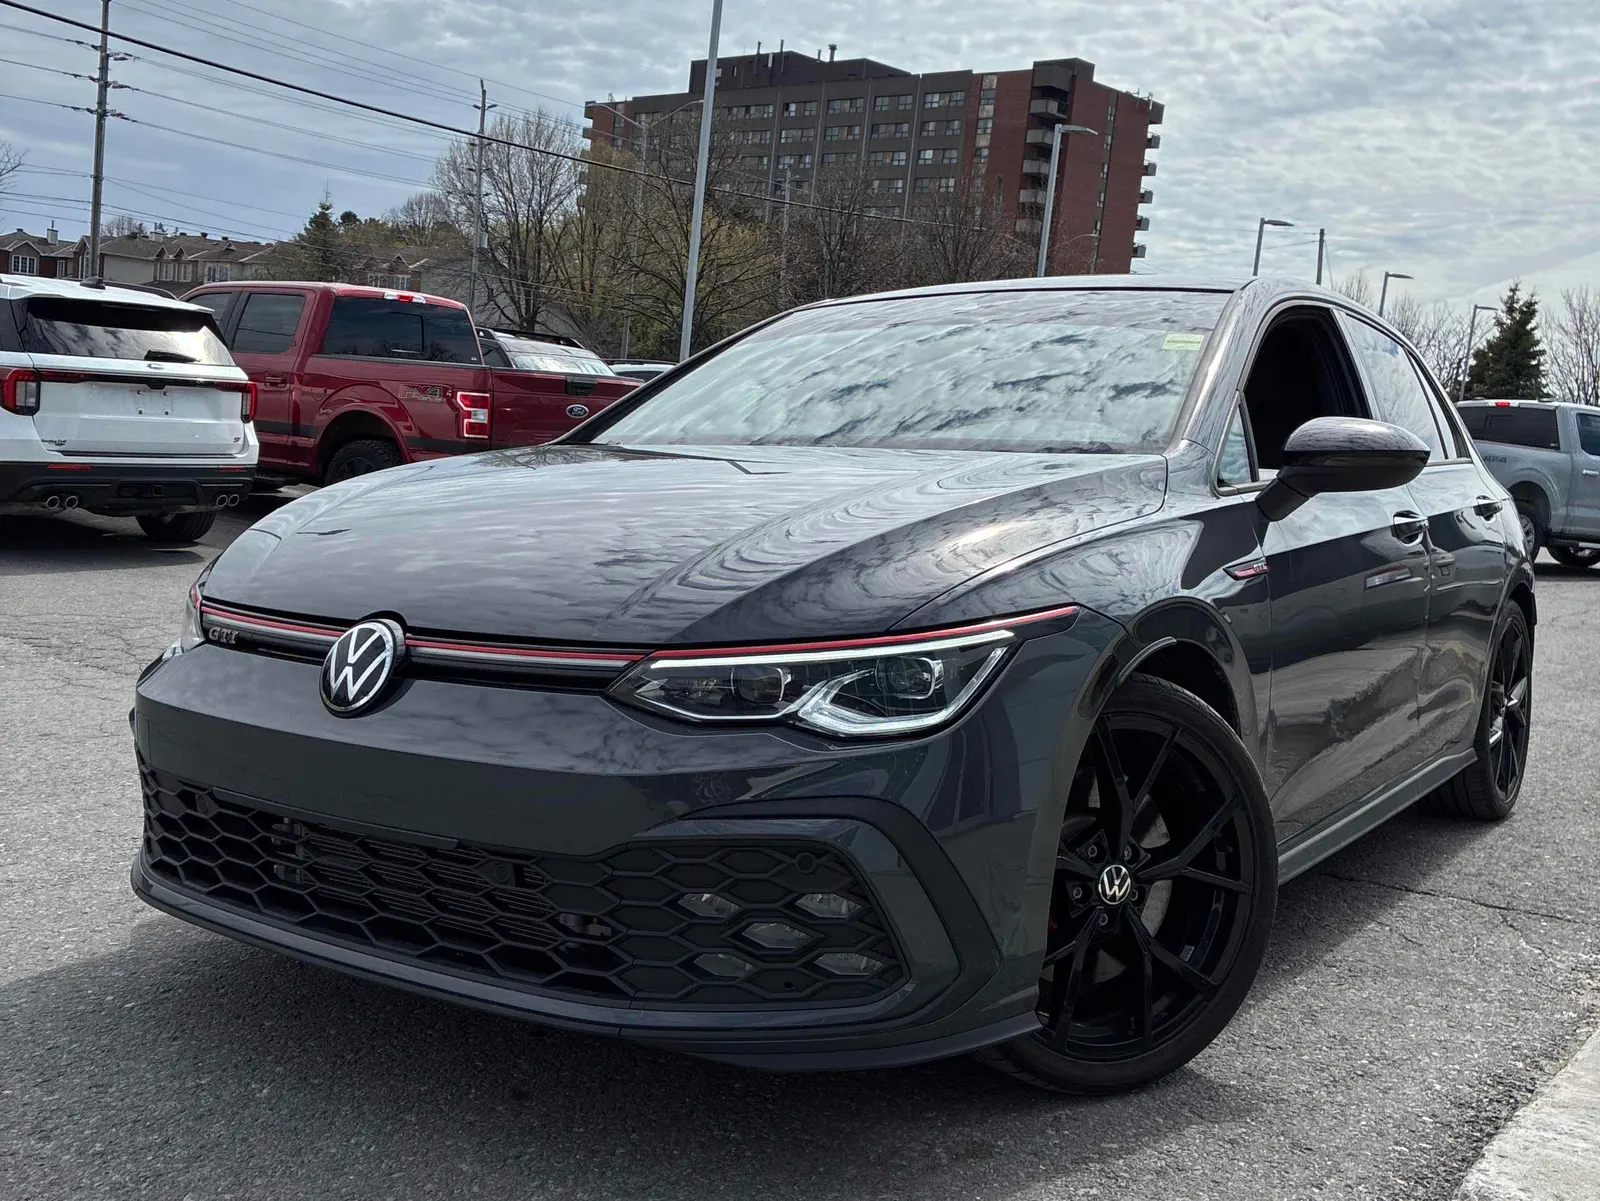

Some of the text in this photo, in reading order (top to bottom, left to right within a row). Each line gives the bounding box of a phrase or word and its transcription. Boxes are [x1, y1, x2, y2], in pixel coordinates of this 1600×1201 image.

[208, 626, 239, 645] GTI
[324, 624, 392, 706] VW
[1100, 866, 1131, 903] VW
